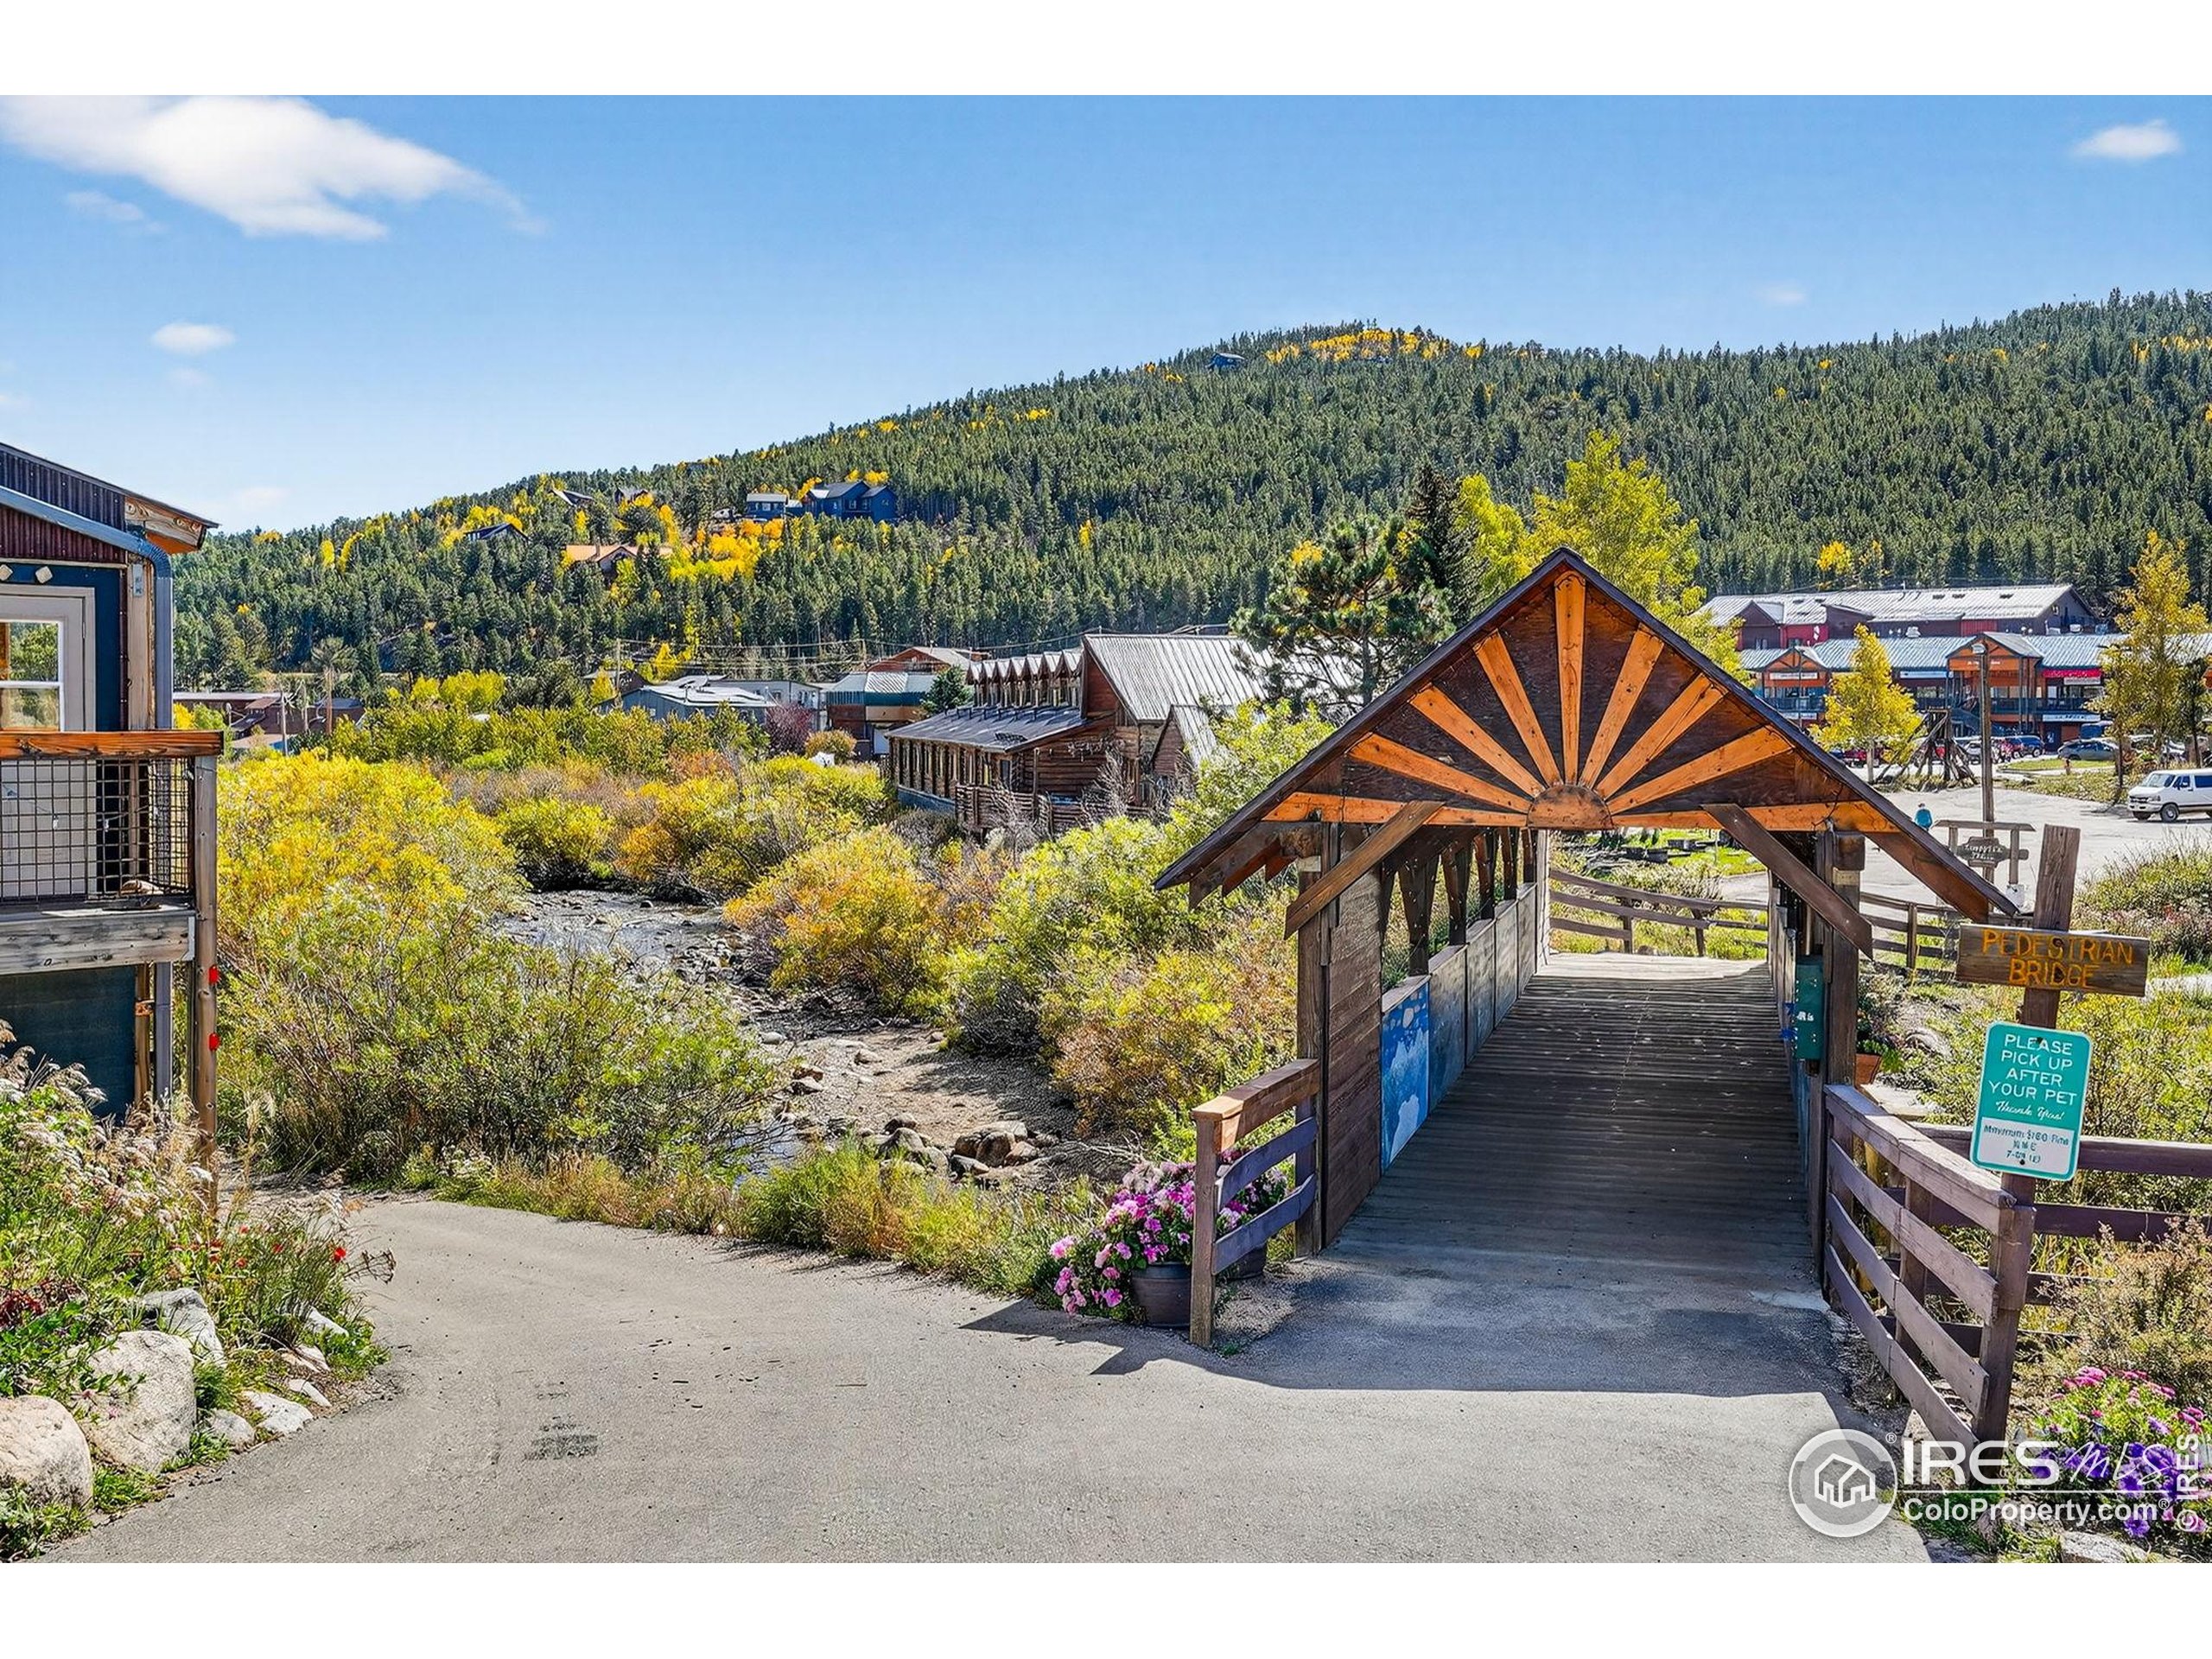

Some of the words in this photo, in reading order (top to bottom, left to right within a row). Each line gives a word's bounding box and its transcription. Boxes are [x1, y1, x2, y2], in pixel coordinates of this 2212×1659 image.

[1981, 928, 2135, 965] PEDESTRIAN
[2009, 957, 2100, 989] BRIDGE
[2004, 1033, 2073, 1056] PLEASE
[2001, 1050, 2041, 1068] PICK
[2048, 1056, 2074, 1071] UP
[2005, 1067, 2063, 1088] AFTER
[1988, 1080, 2037, 1100] YOUR
[2044, 1089, 2078, 1106] PET
